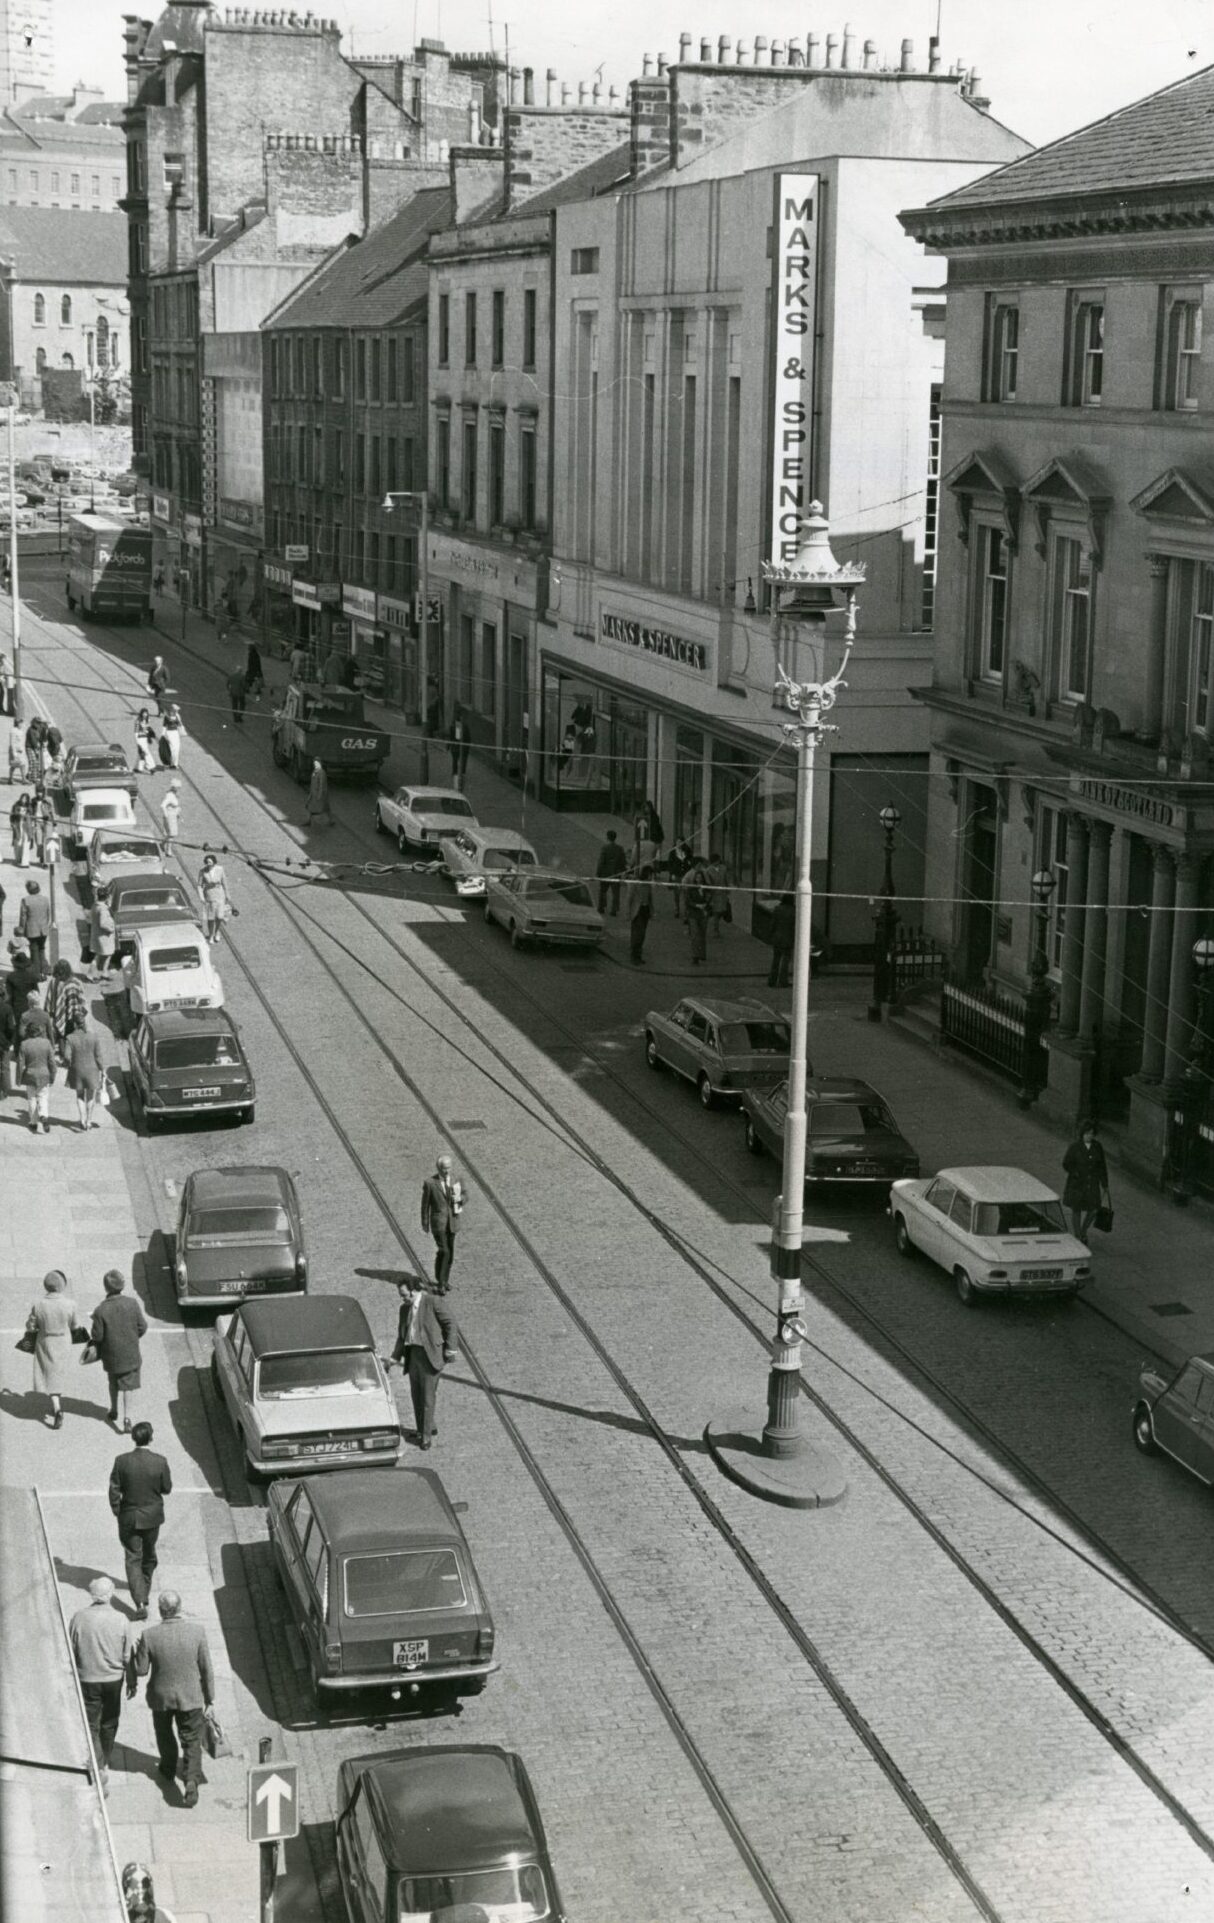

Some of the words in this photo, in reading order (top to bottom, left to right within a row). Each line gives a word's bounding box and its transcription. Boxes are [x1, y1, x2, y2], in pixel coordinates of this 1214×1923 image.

[784, 198, 813, 336] MARKS
[783, 357, 806, 380] &
[779, 402, 806, 562] SPENCE
[602, 614, 639, 646] MARKS
[638, 627, 647, 649] &
[648, 629, 705, 671] SPENCER
[340, 738, 378, 750] GAS
[399, 1642, 424, 1653] XSP
